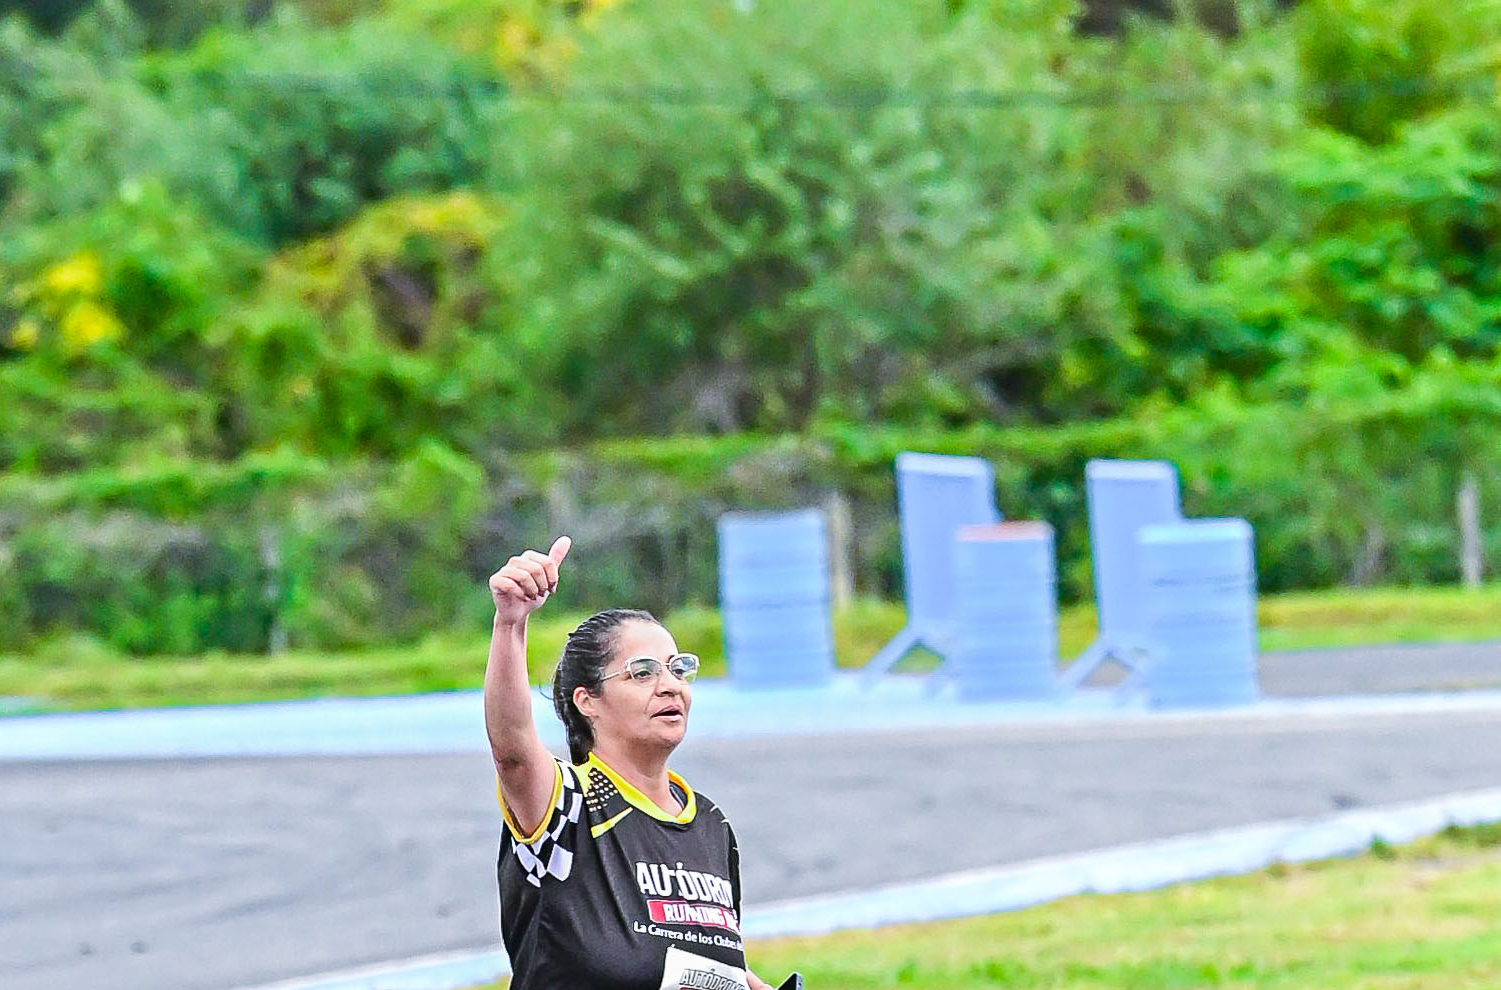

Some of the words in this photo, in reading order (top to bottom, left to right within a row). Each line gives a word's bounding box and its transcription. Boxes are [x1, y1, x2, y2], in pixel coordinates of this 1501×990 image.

[633, 920, 647, 934] La
[647, 924, 684, 940] Carrera
[684, 930, 698, 942] de
[698, 932, 713, 945] los
